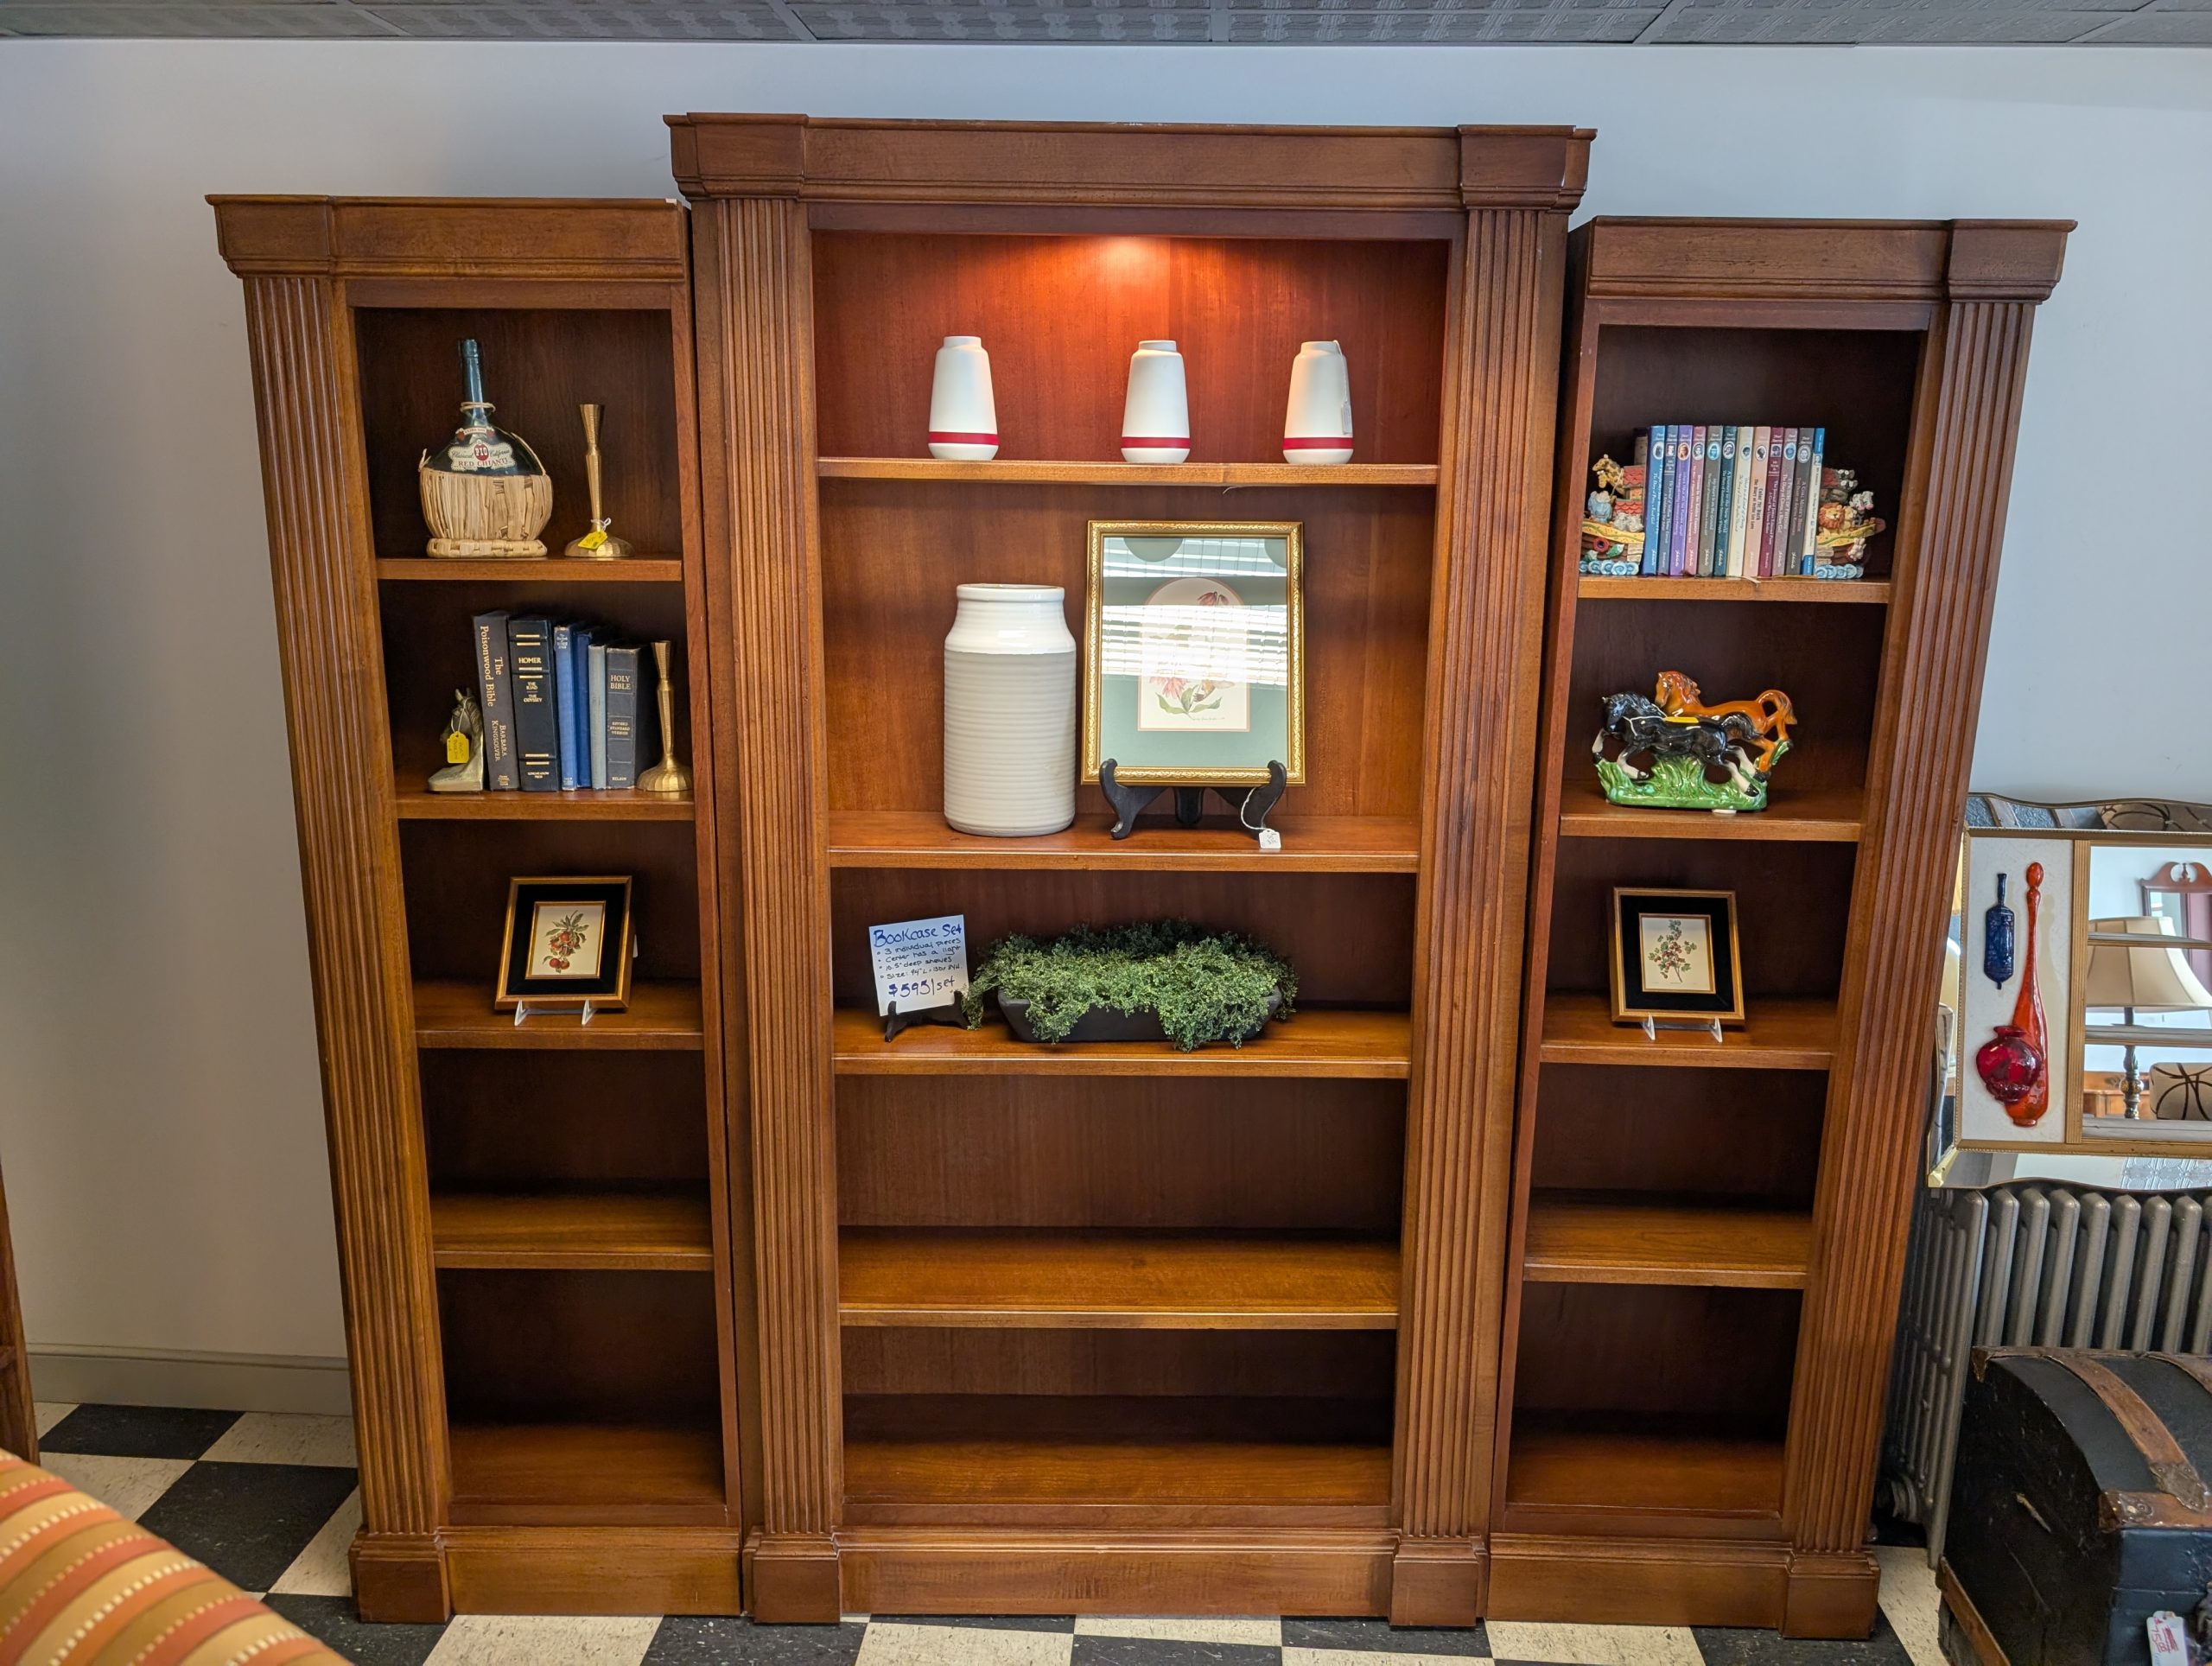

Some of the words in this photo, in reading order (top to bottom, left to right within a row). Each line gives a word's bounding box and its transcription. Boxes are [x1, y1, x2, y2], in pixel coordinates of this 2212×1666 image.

[480, 626, 493, 681] Poisonwood
[494, 657, 504, 675] The
[486, 683, 496, 707] Bible
[492, 720, 500, 761] KINGSOLVER
[942, 923, 962, 937] Set
[894, 942, 933, 953] individual
[942, 945, 962, 956] light
[925, 956, 952, 964] shelves
